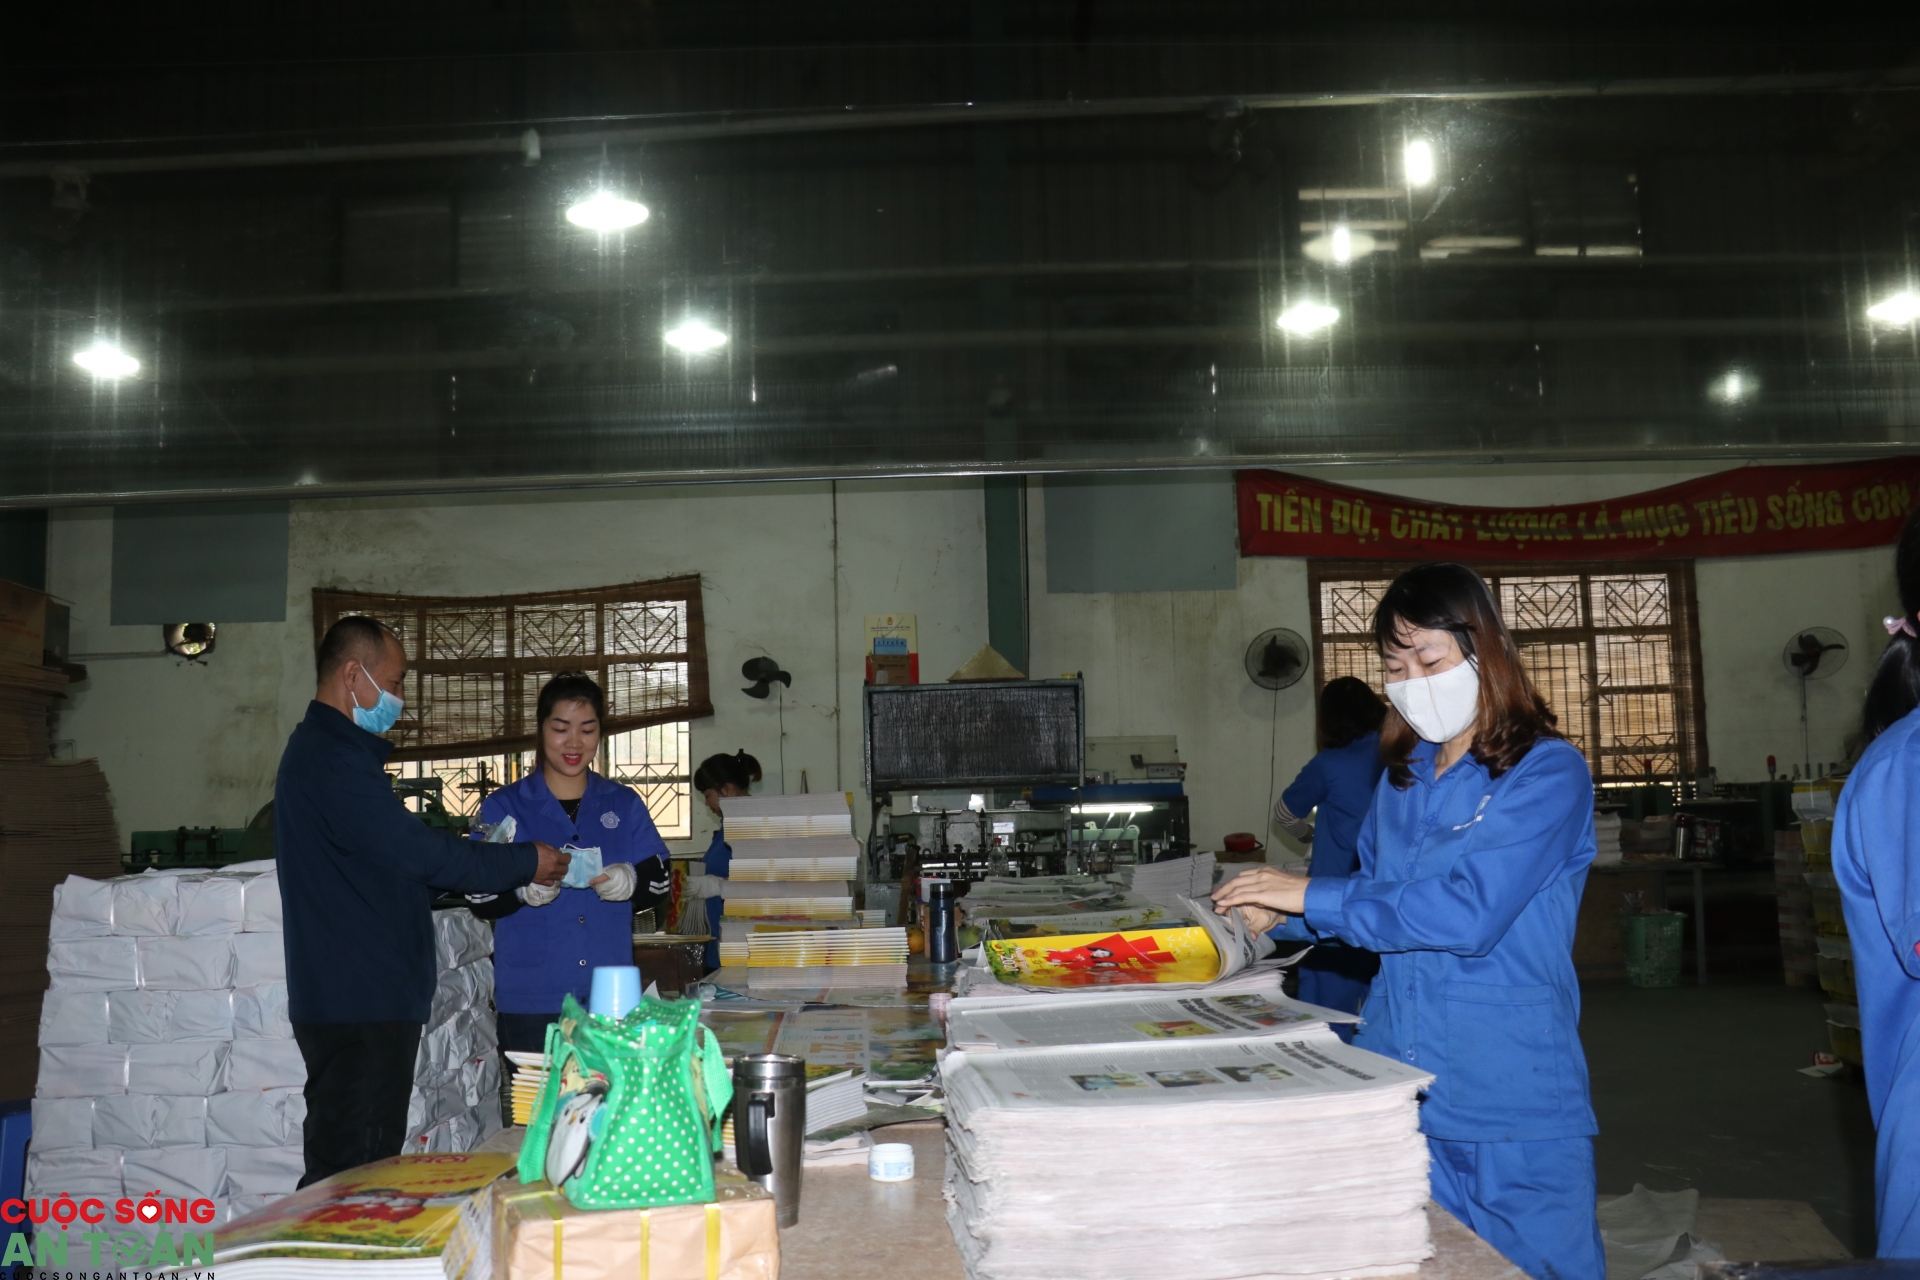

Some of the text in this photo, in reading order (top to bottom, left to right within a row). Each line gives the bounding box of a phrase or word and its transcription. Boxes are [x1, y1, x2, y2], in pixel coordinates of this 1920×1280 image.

[1331, 498, 1380, 544] ĐỘ,
[1472, 511, 1573, 549] LƯỢNG
[1577, 504, 1617, 540] LÀ
[1621, 503, 1690, 546] MỤC
[1693, 491, 1759, 535] TIÊU
[1766, 479, 1846, 530] SỐNG
